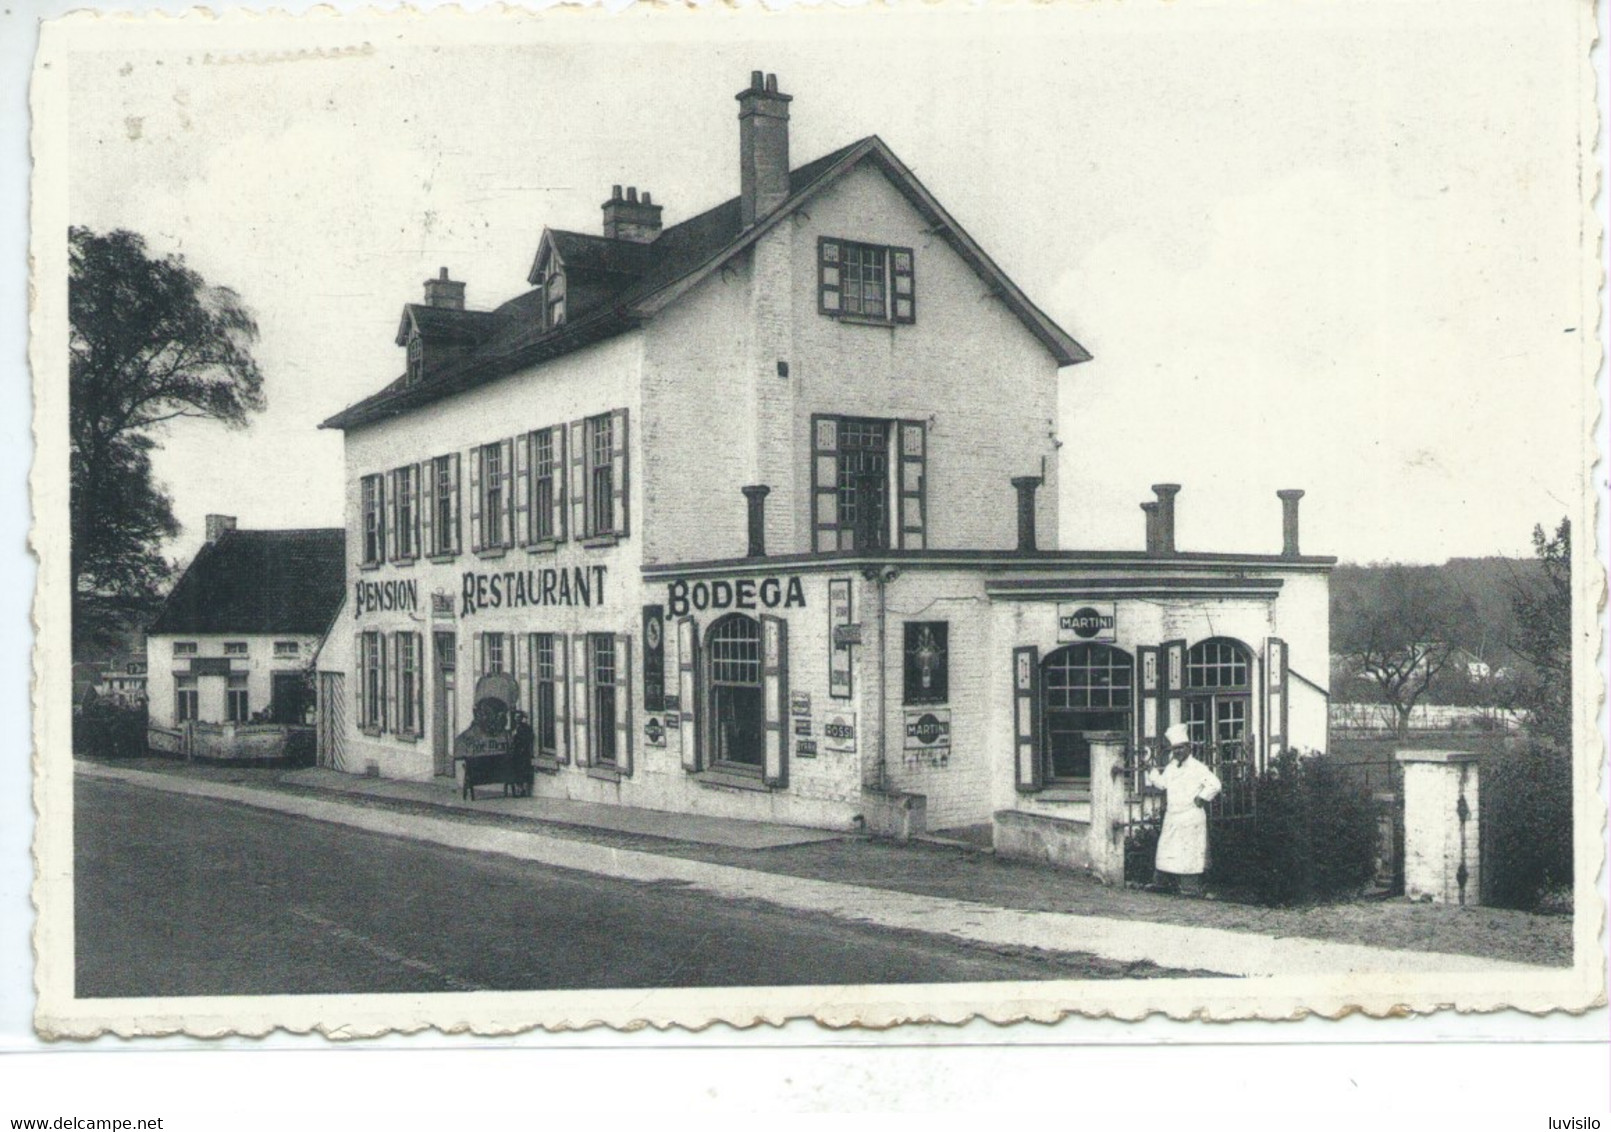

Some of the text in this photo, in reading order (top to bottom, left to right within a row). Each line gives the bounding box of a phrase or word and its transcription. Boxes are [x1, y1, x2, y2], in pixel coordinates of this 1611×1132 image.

[355, 579, 419, 620] PENSION
[460, 565, 607, 618] RESTAURANT
[666, 576, 806, 621] BODEGA
[1062, 617, 1111, 628] MARTINI
[826, 725, 853, 738] ROSSI
[908, 724, 949, 736] MARTINI
